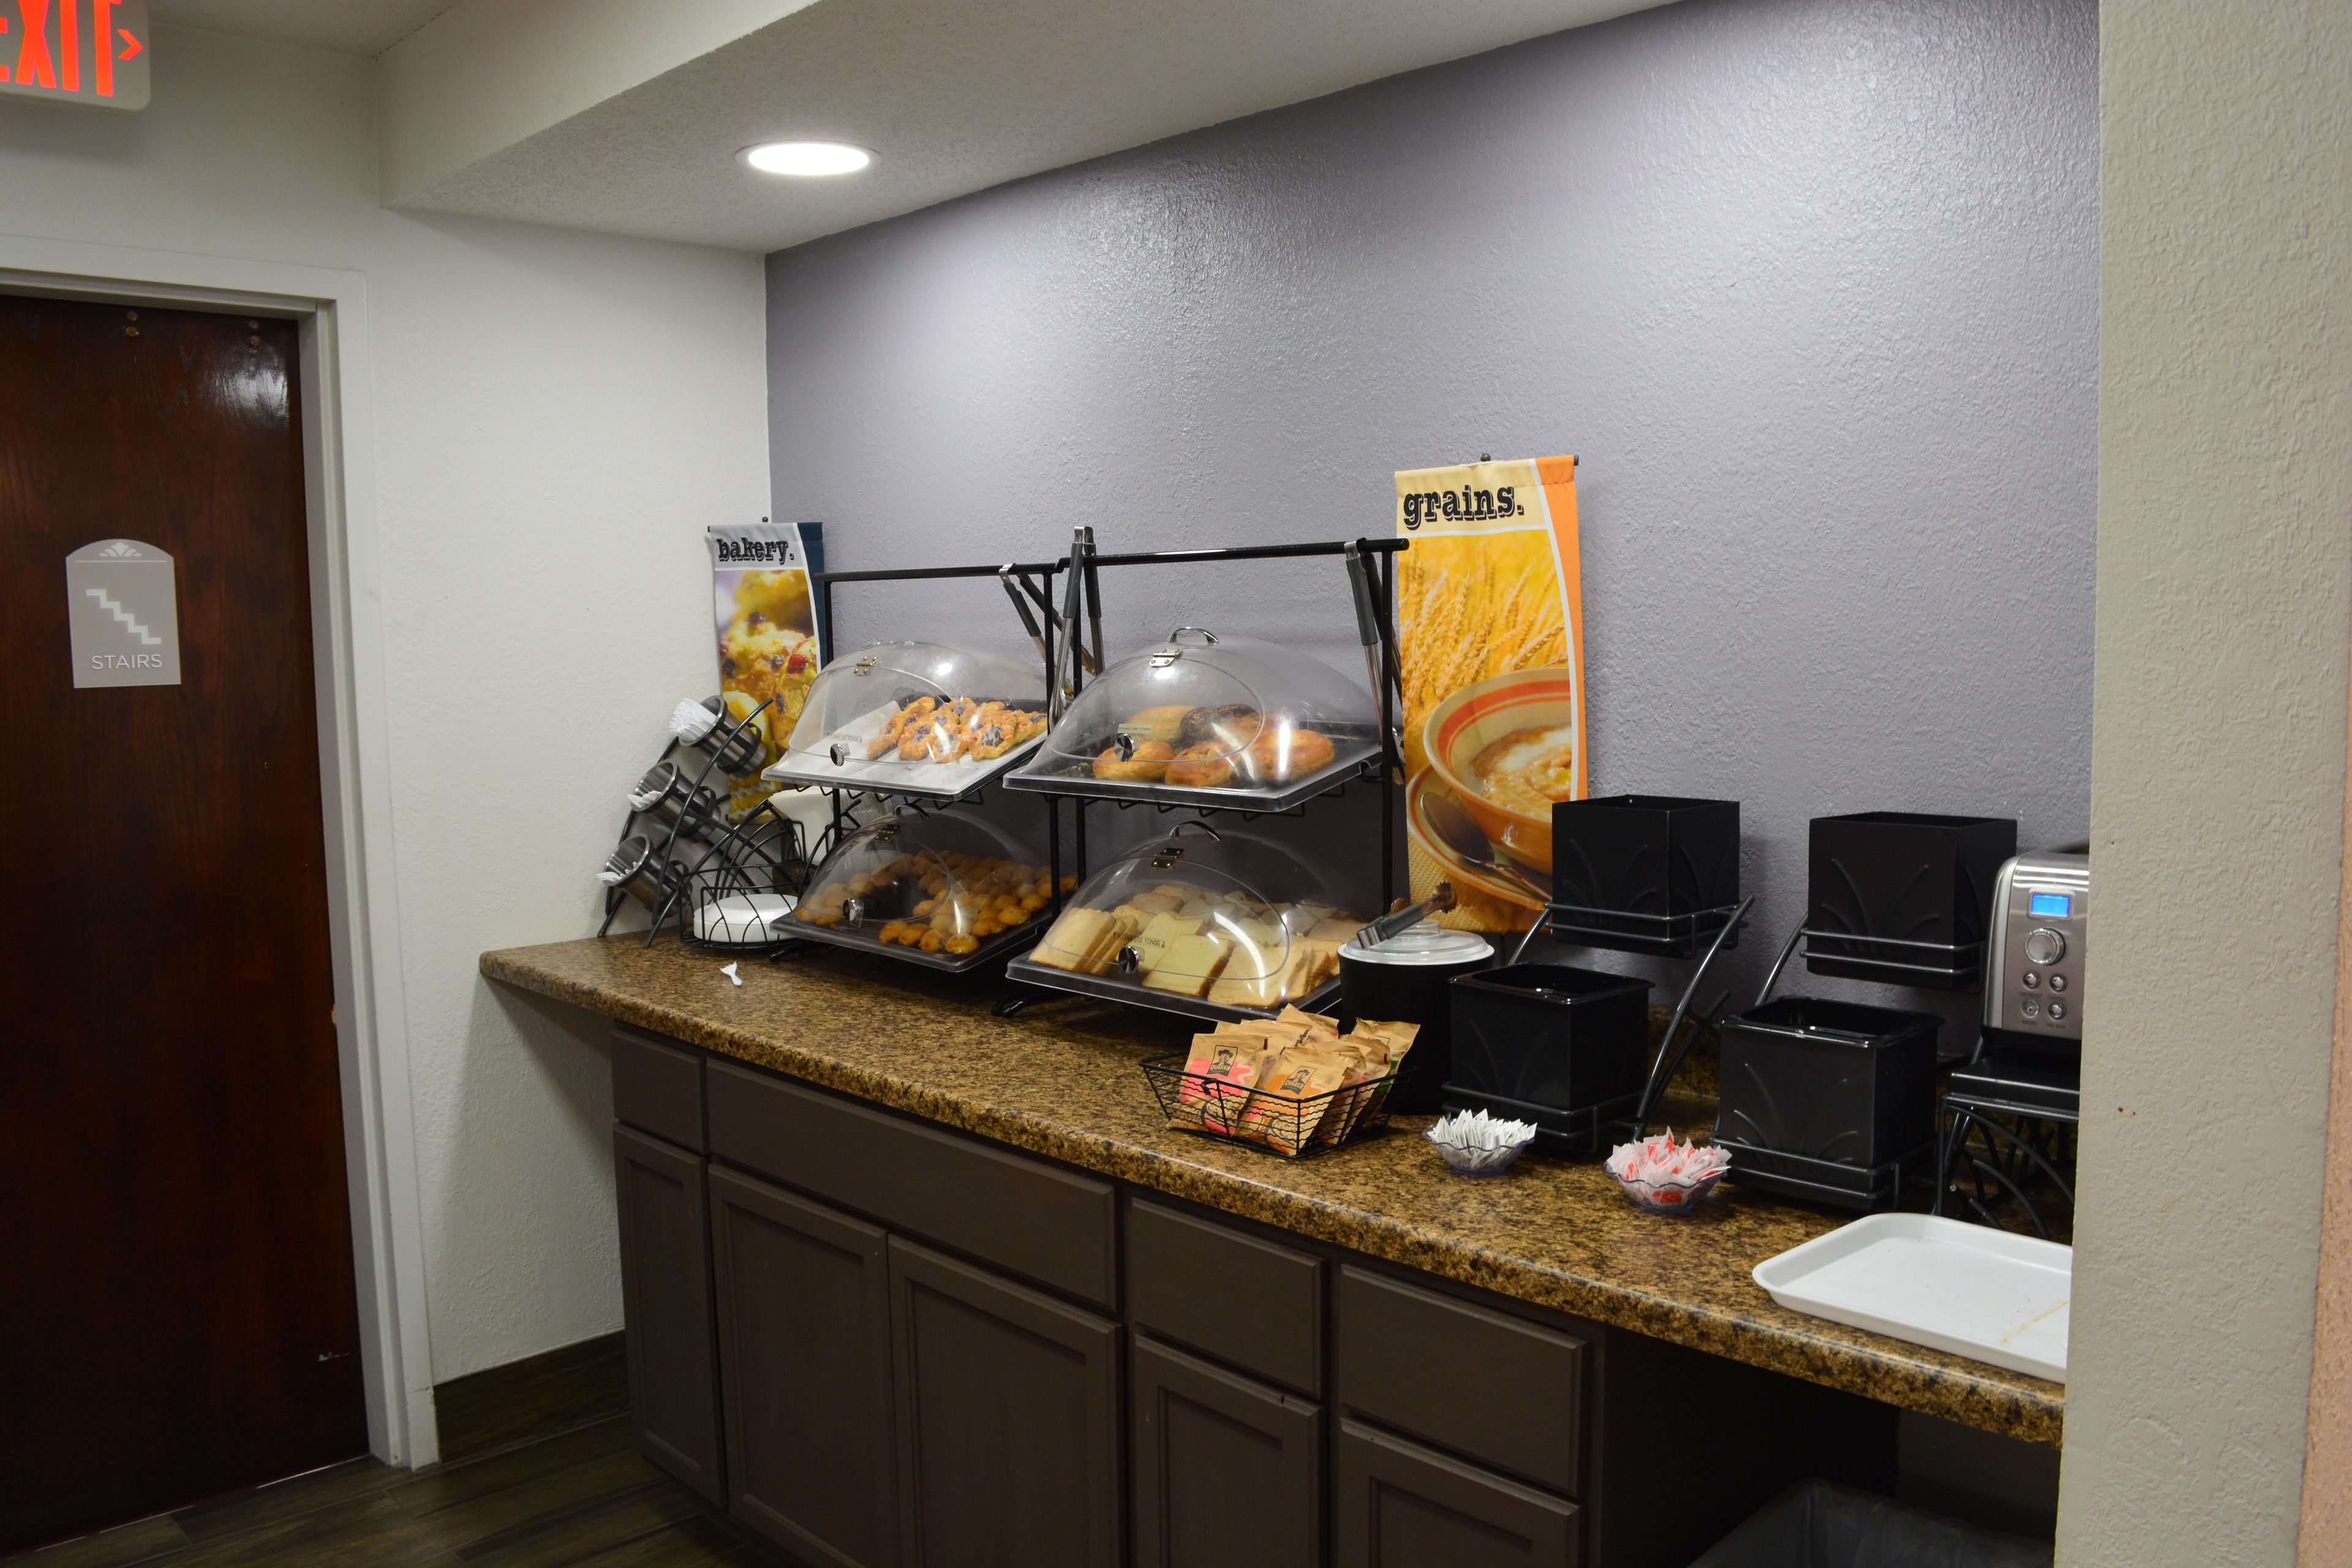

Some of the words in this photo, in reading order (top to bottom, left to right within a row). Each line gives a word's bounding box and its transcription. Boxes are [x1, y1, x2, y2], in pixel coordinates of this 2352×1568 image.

[0, 0, 122, 97] XIT
[1403, 484, 1525, 530] grains.
[716, 537, 794, 565] bakery.
[92, 654, 162, 669] STAIRS
[1284, 1080, 1305, 1090] QUAKER
